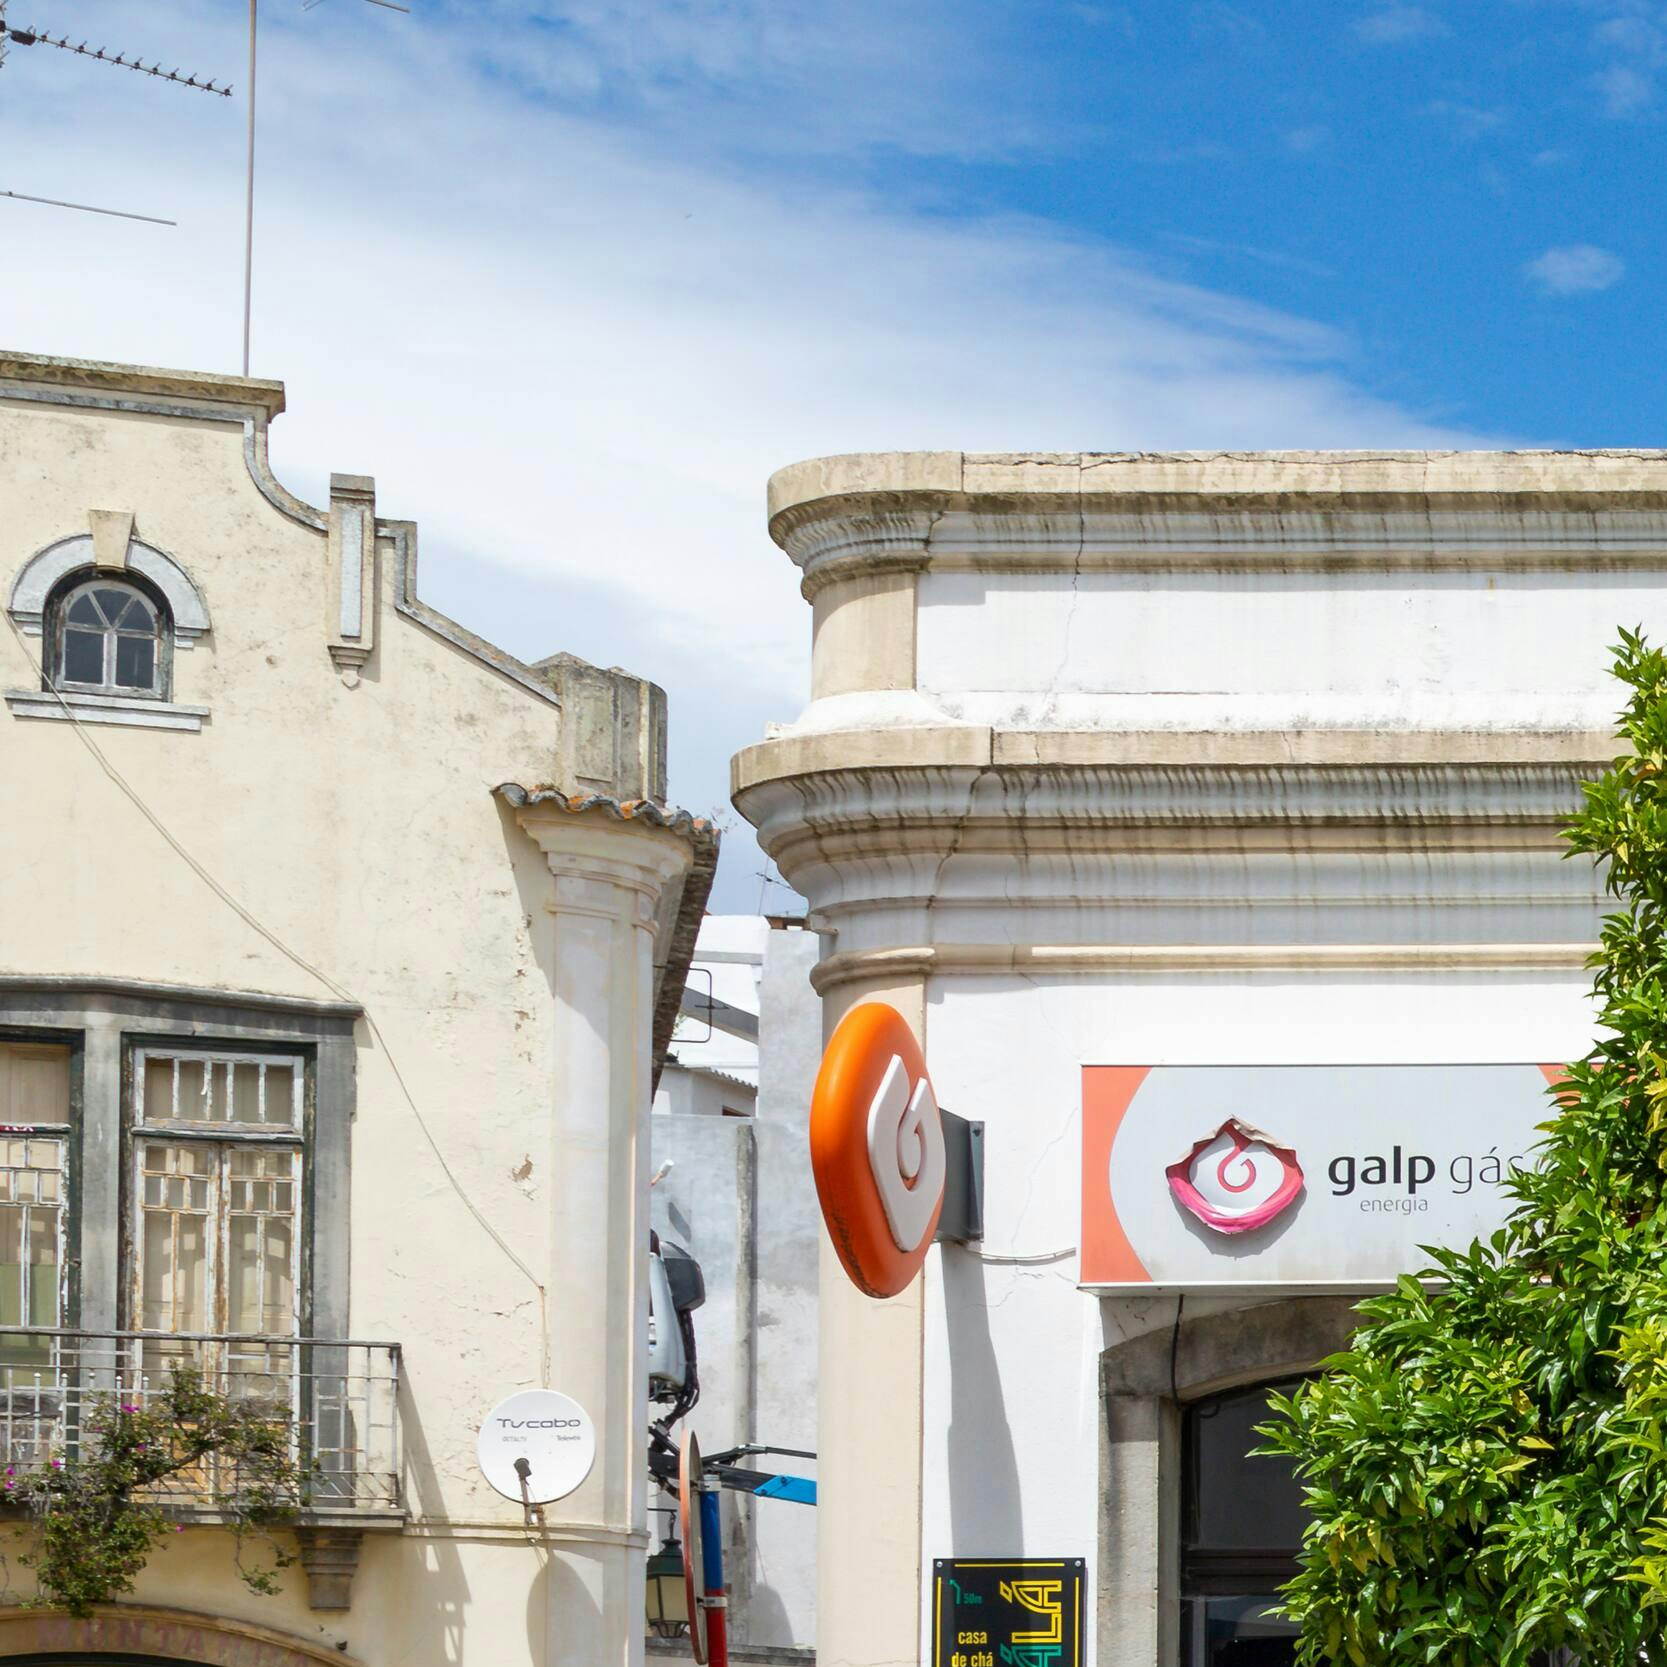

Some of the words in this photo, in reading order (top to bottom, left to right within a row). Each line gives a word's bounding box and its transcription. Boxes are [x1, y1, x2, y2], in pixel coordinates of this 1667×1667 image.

[1328, 1145, 1436, 1196] galp
[1450, 1146, 1524, 1194] gás
[1360, 1198, 1429, 1216] energia
[958, 1631, 988, 1645] casa
[951, 1652, 969, 1667] de
[970, 1651, 994, 1667] chá
